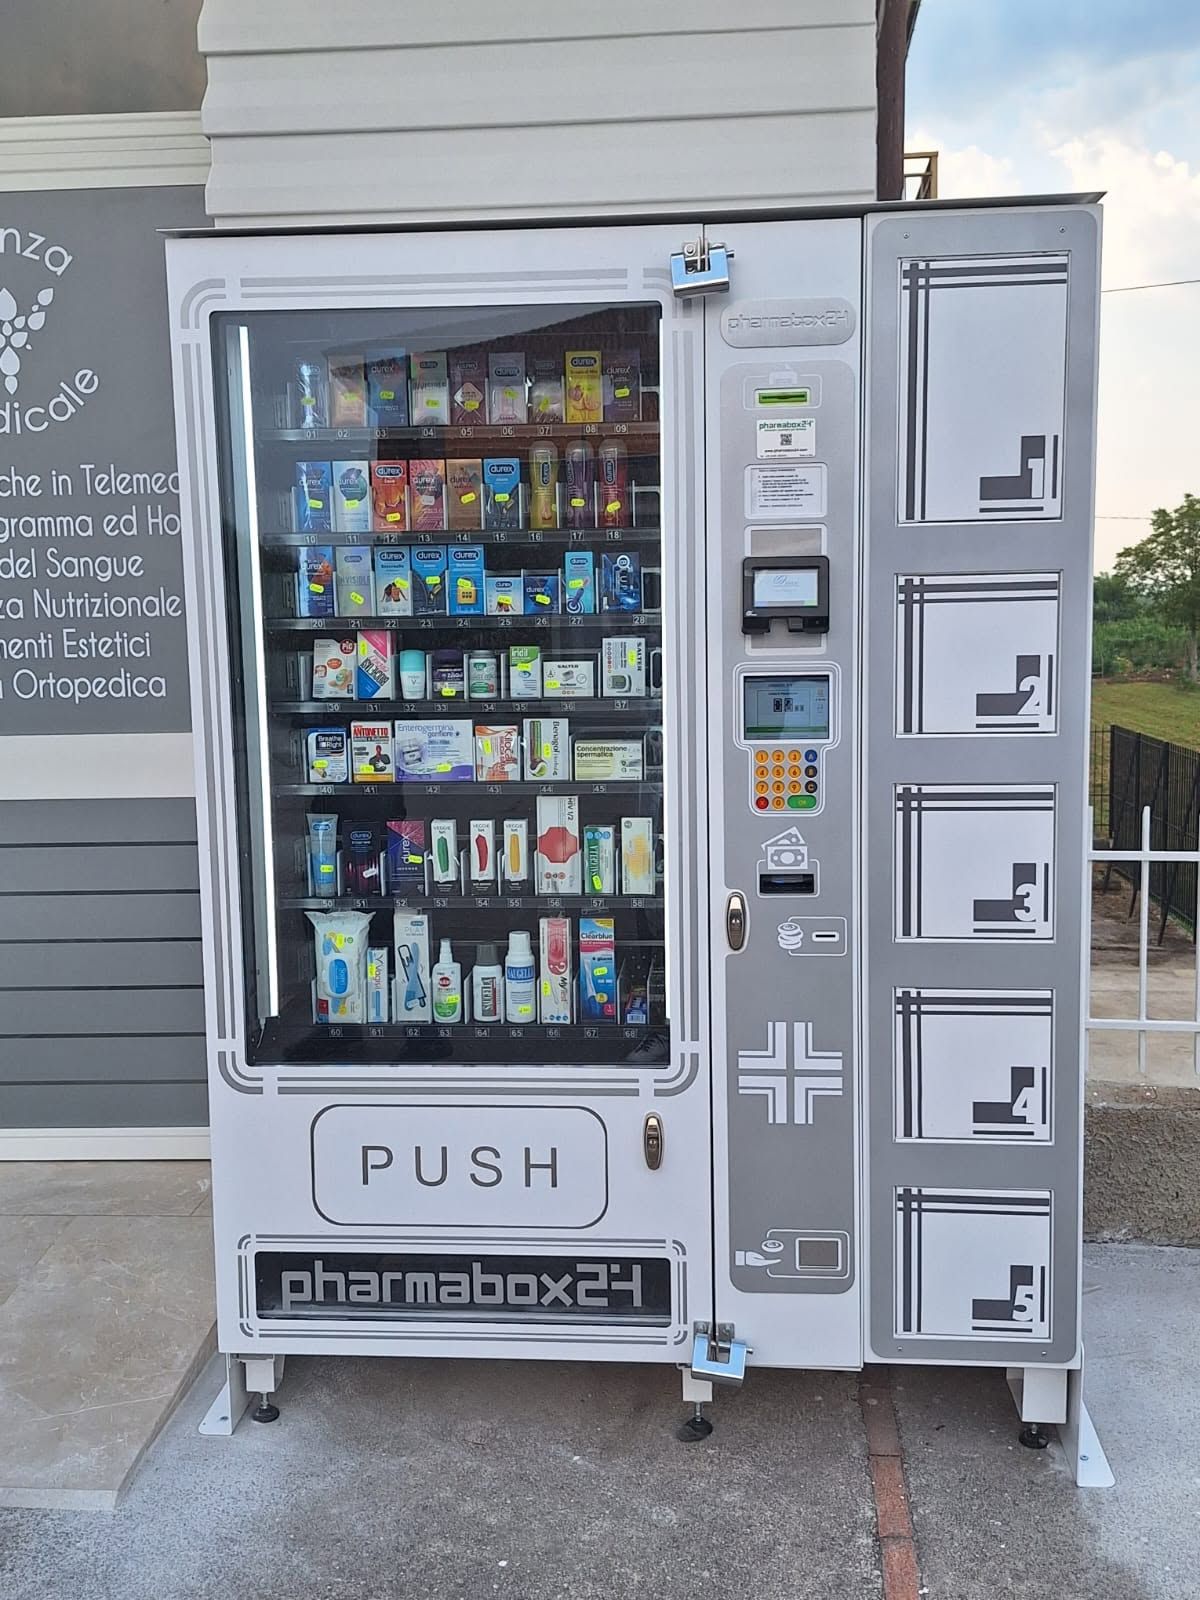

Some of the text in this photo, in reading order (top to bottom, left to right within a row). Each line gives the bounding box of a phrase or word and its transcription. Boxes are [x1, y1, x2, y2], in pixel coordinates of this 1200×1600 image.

[51, 470, 72, 496] in
[378, 467, 401, 475] durex
[491, 465, 513, 473] durex
[1027, 458, 1045, 498] 1
[103, 505, 137, 536] ed
[0, 547, 144, 582] del Sangue
[381, 552, 403, 560] durex
[418, 552, 440, 560] durex
[454, 551, 477, 559] durex
[33, 587, 182, 618] Nutrizionale
[63, 628, 151, 658] Estetici
[13, 668, 166, 704] Ortopedica
[1017, 676, 1041, 715] 2
[397, 723, 454, 735] Enterogermina
[1014, 883, 1037, 922] 3
[1012, 1086, 1036, 1124] 4
[361, 1145, 558, 1188] PUSH
[281, 1260, 642, 1311] pharmabox24
[1012, 1285, 1033, 1321] 5
